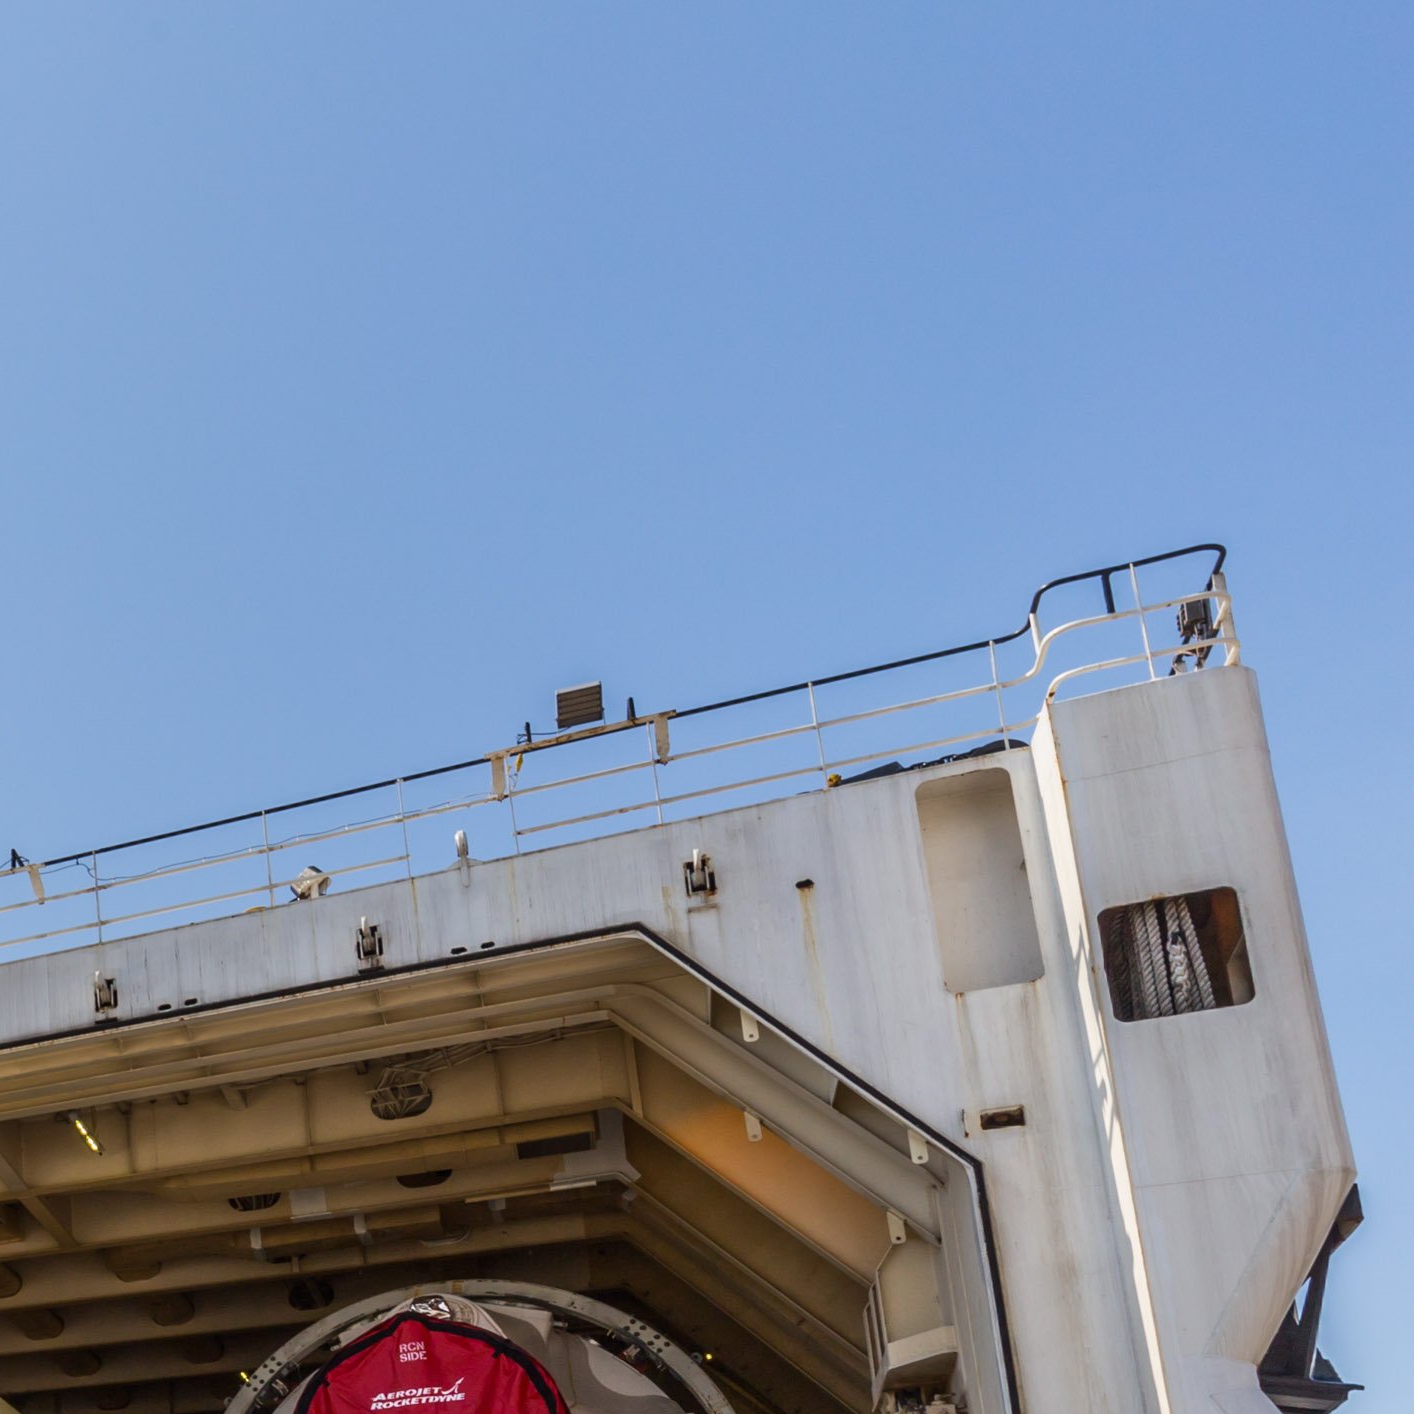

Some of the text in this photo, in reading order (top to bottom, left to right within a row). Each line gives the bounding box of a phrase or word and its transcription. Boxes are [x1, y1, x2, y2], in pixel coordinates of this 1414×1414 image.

[399, 1341, 425, 1353] RCN
[399, 1351, 427, 1363] SIDE
[371, 1386, 442, 1402] AEROJET
[370, 1393, 466, 1411] ROCKETDYNE
